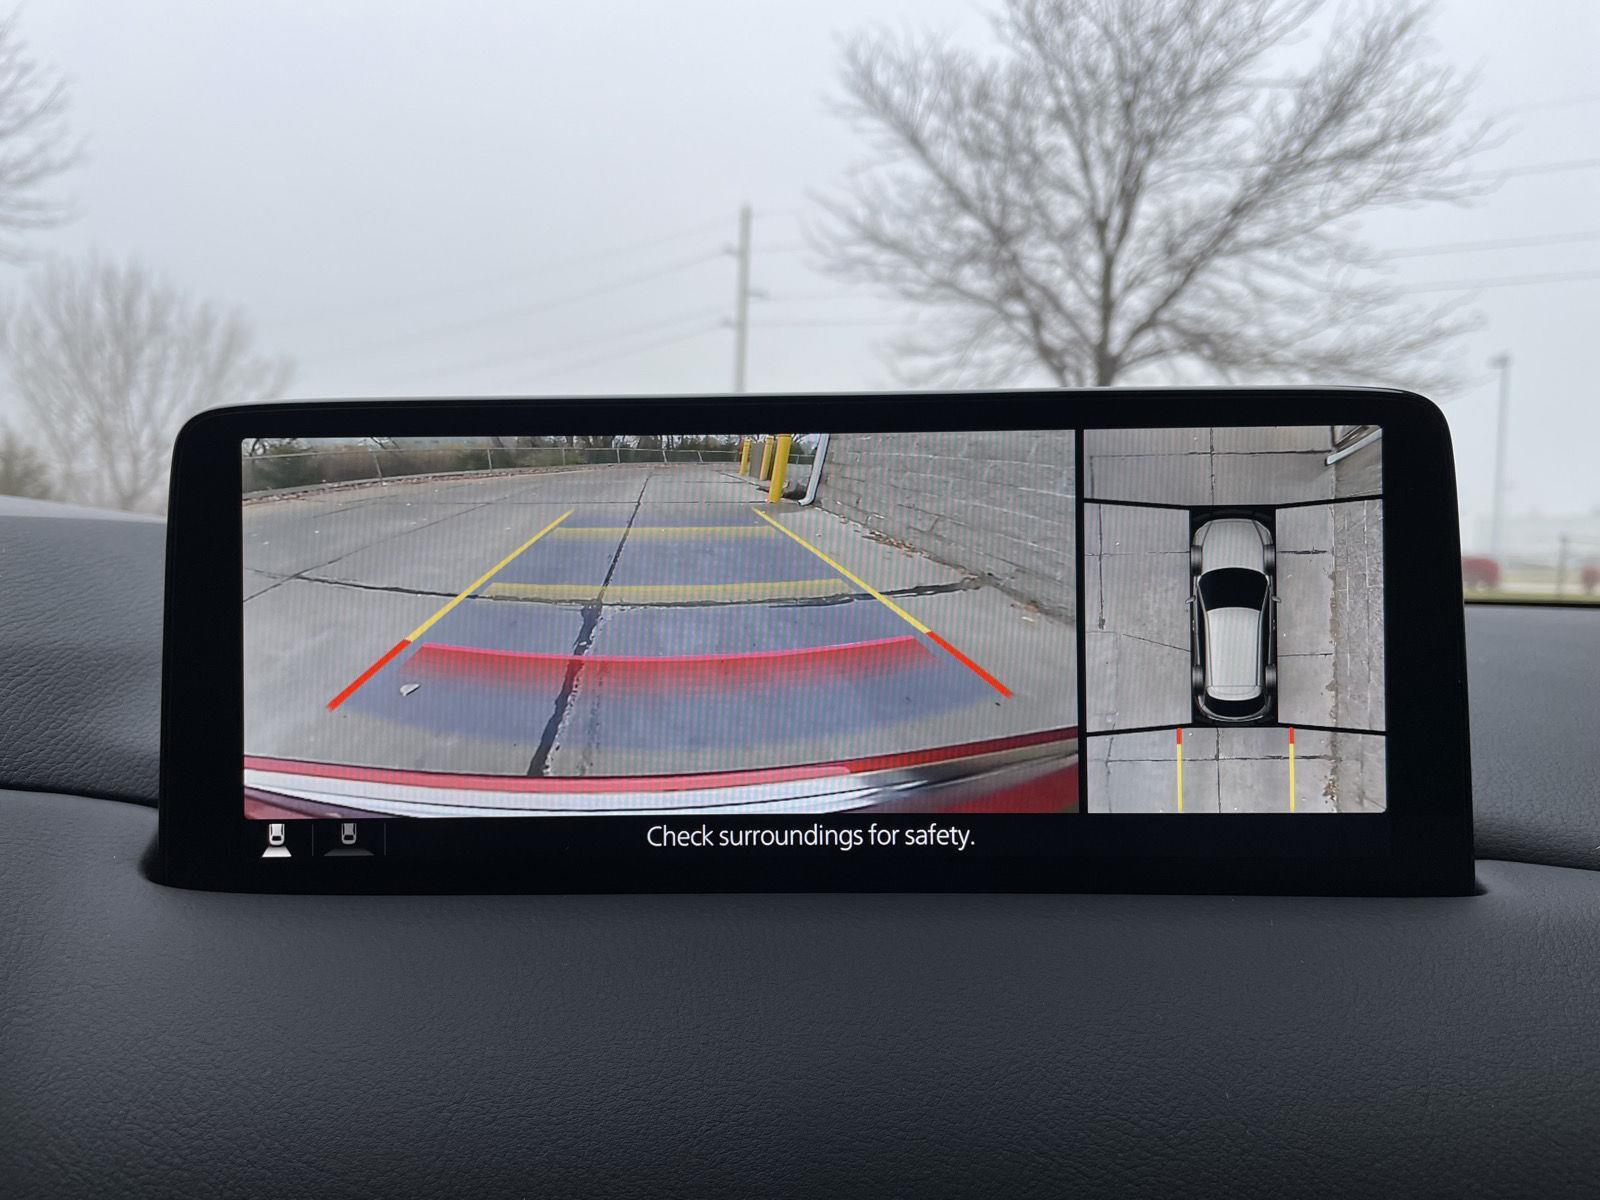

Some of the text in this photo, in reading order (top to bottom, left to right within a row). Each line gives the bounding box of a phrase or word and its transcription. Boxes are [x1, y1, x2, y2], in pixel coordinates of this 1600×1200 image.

[646, 823, 976, 851] Check surroundings for safety.
